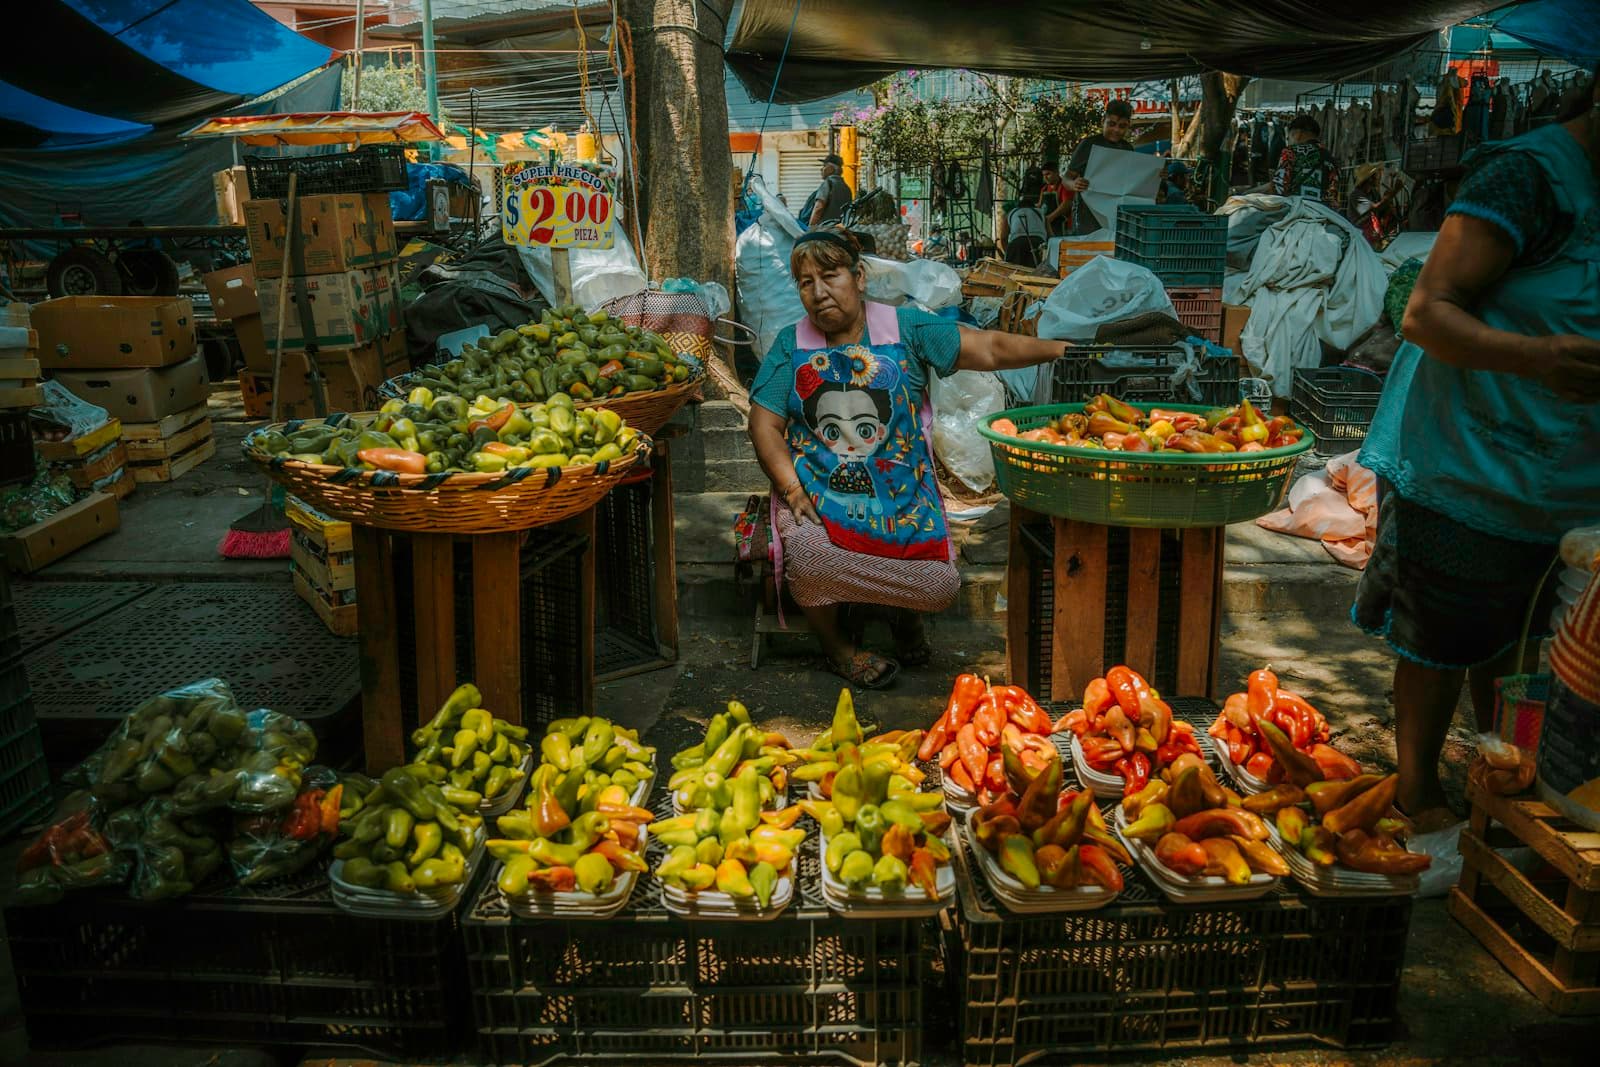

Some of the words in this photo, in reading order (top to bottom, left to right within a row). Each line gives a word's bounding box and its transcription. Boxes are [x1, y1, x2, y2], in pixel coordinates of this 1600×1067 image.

[513, 166, 553, 186] SUPER
[557, 167, 602, 189] PRECIO
[574, 228, 599, 241] PIEZA
